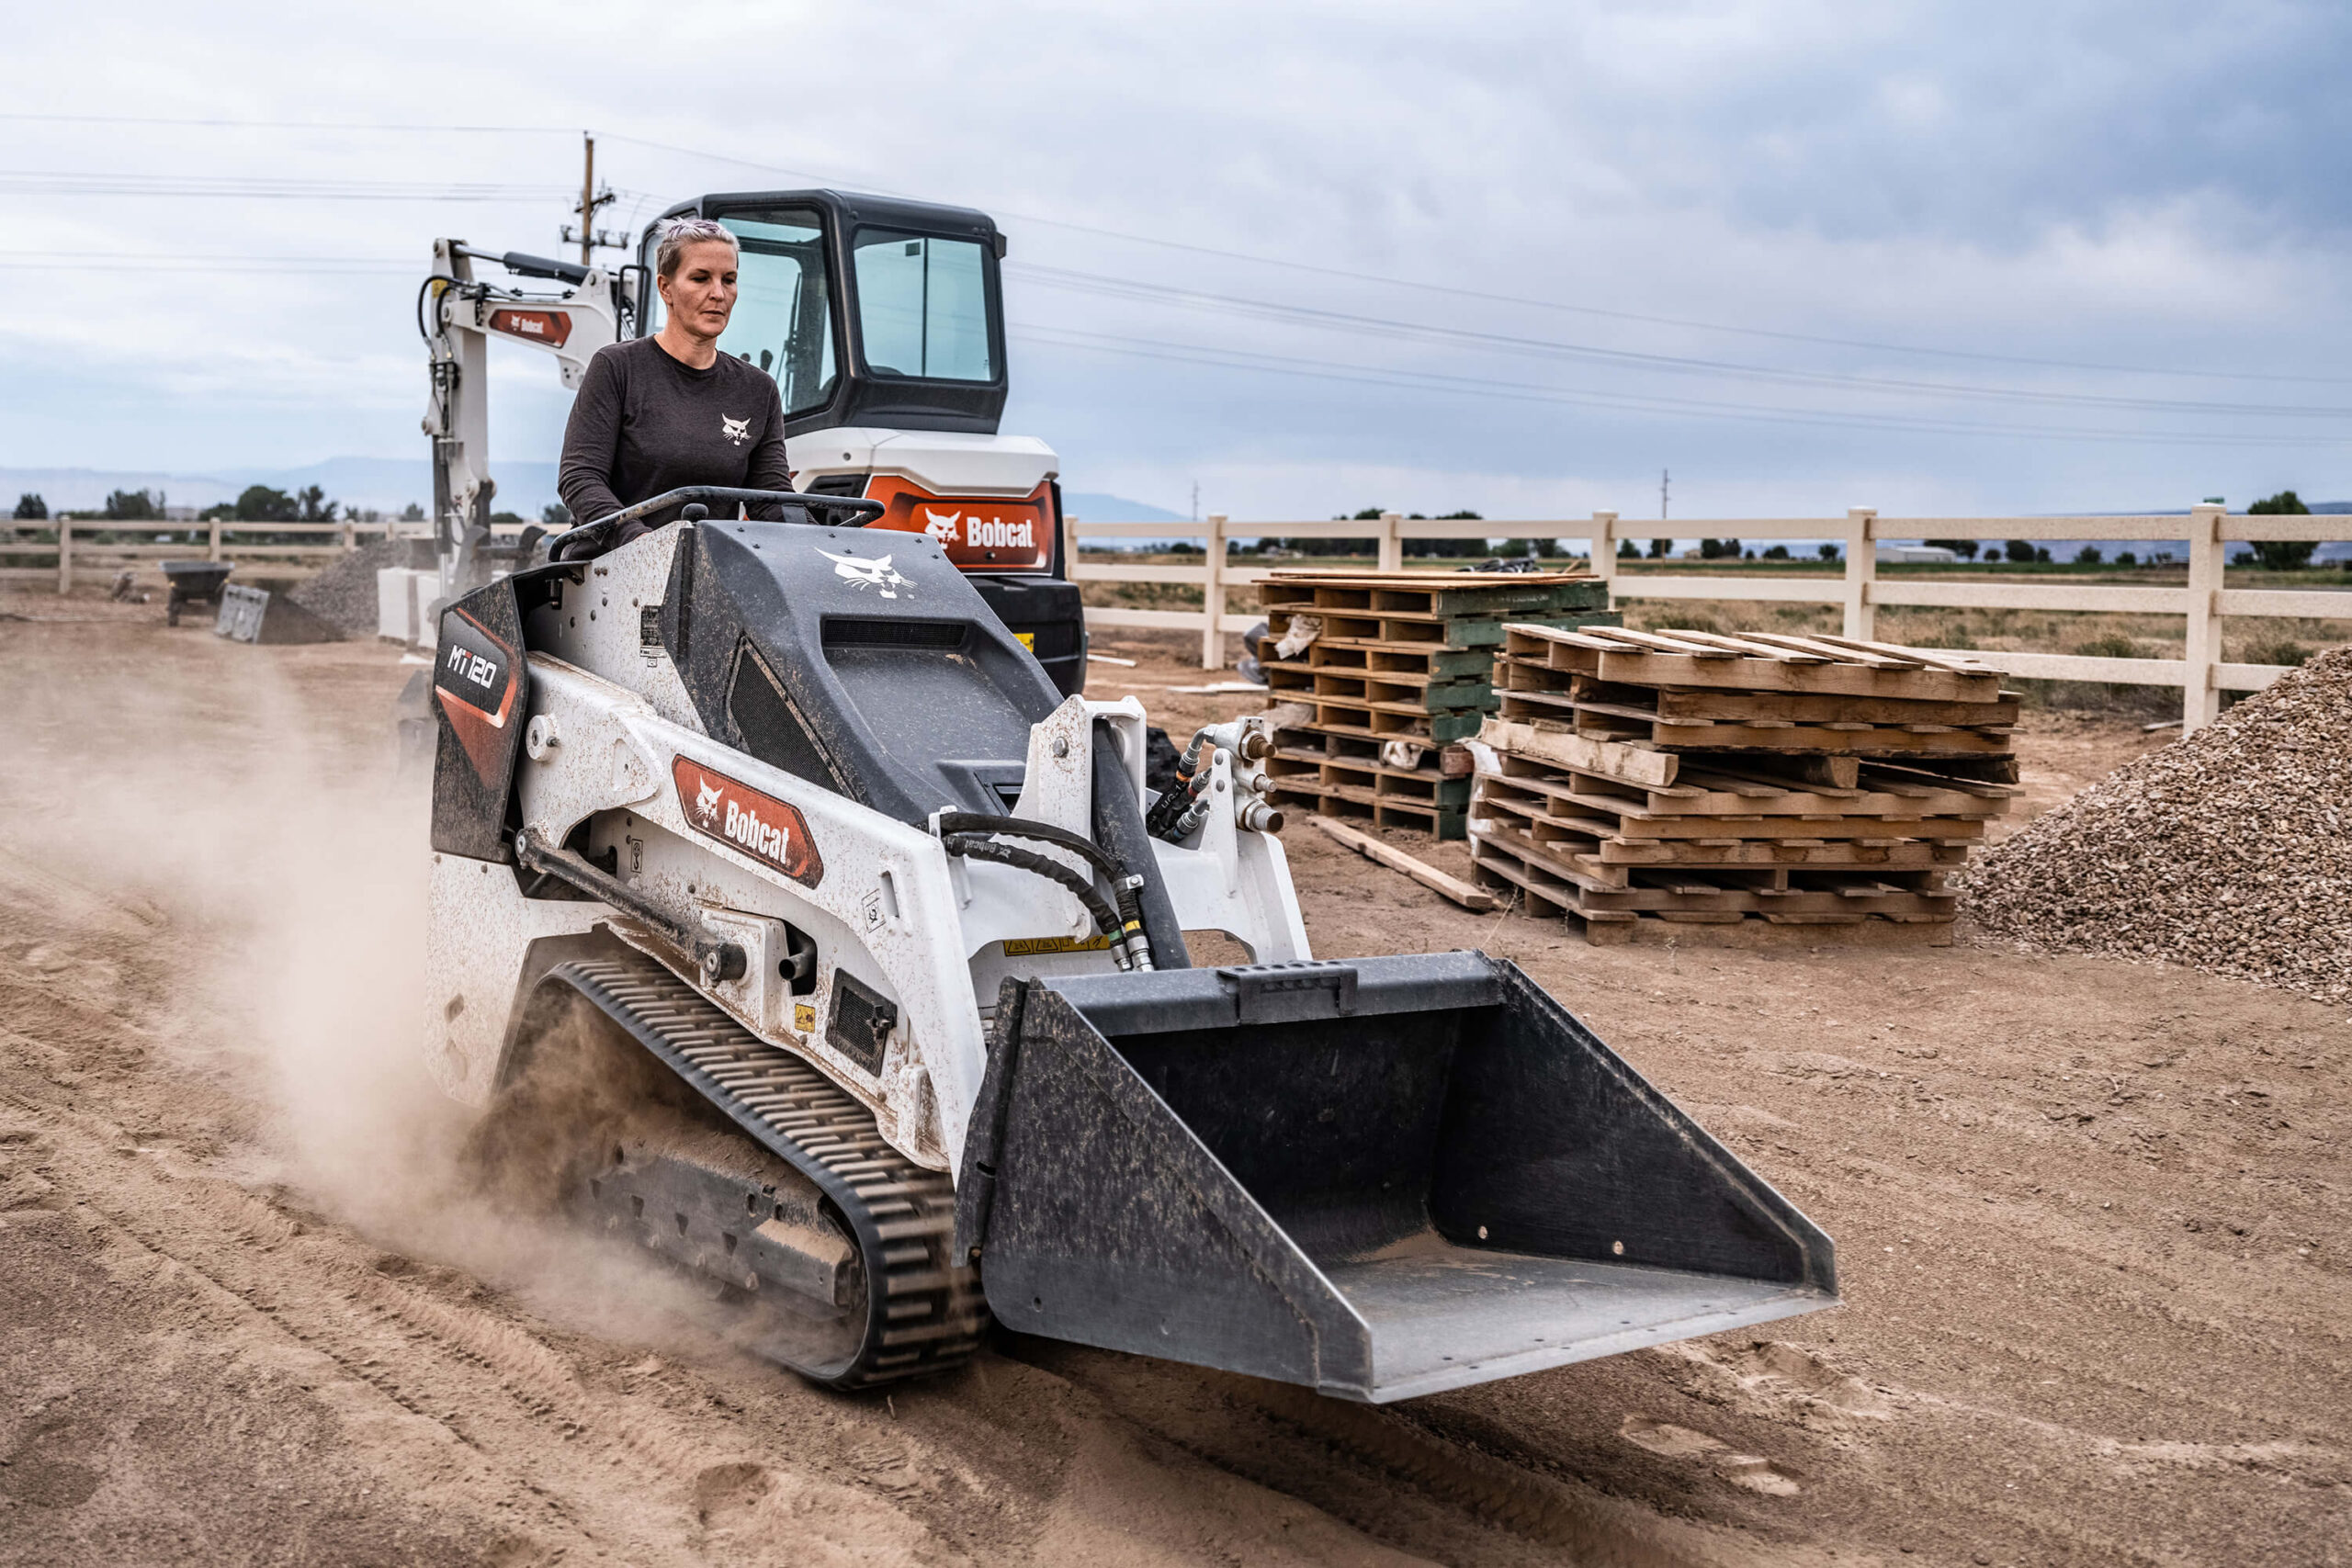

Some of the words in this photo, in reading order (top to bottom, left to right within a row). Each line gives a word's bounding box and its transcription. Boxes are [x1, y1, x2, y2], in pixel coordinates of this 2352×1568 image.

[967, 516, 1033, 547] Bobcat
[447, 644, 497, 689] MT120
[724, 799, 789, 864] Bobcat
[964, 839, 997, 853] Bobcat
